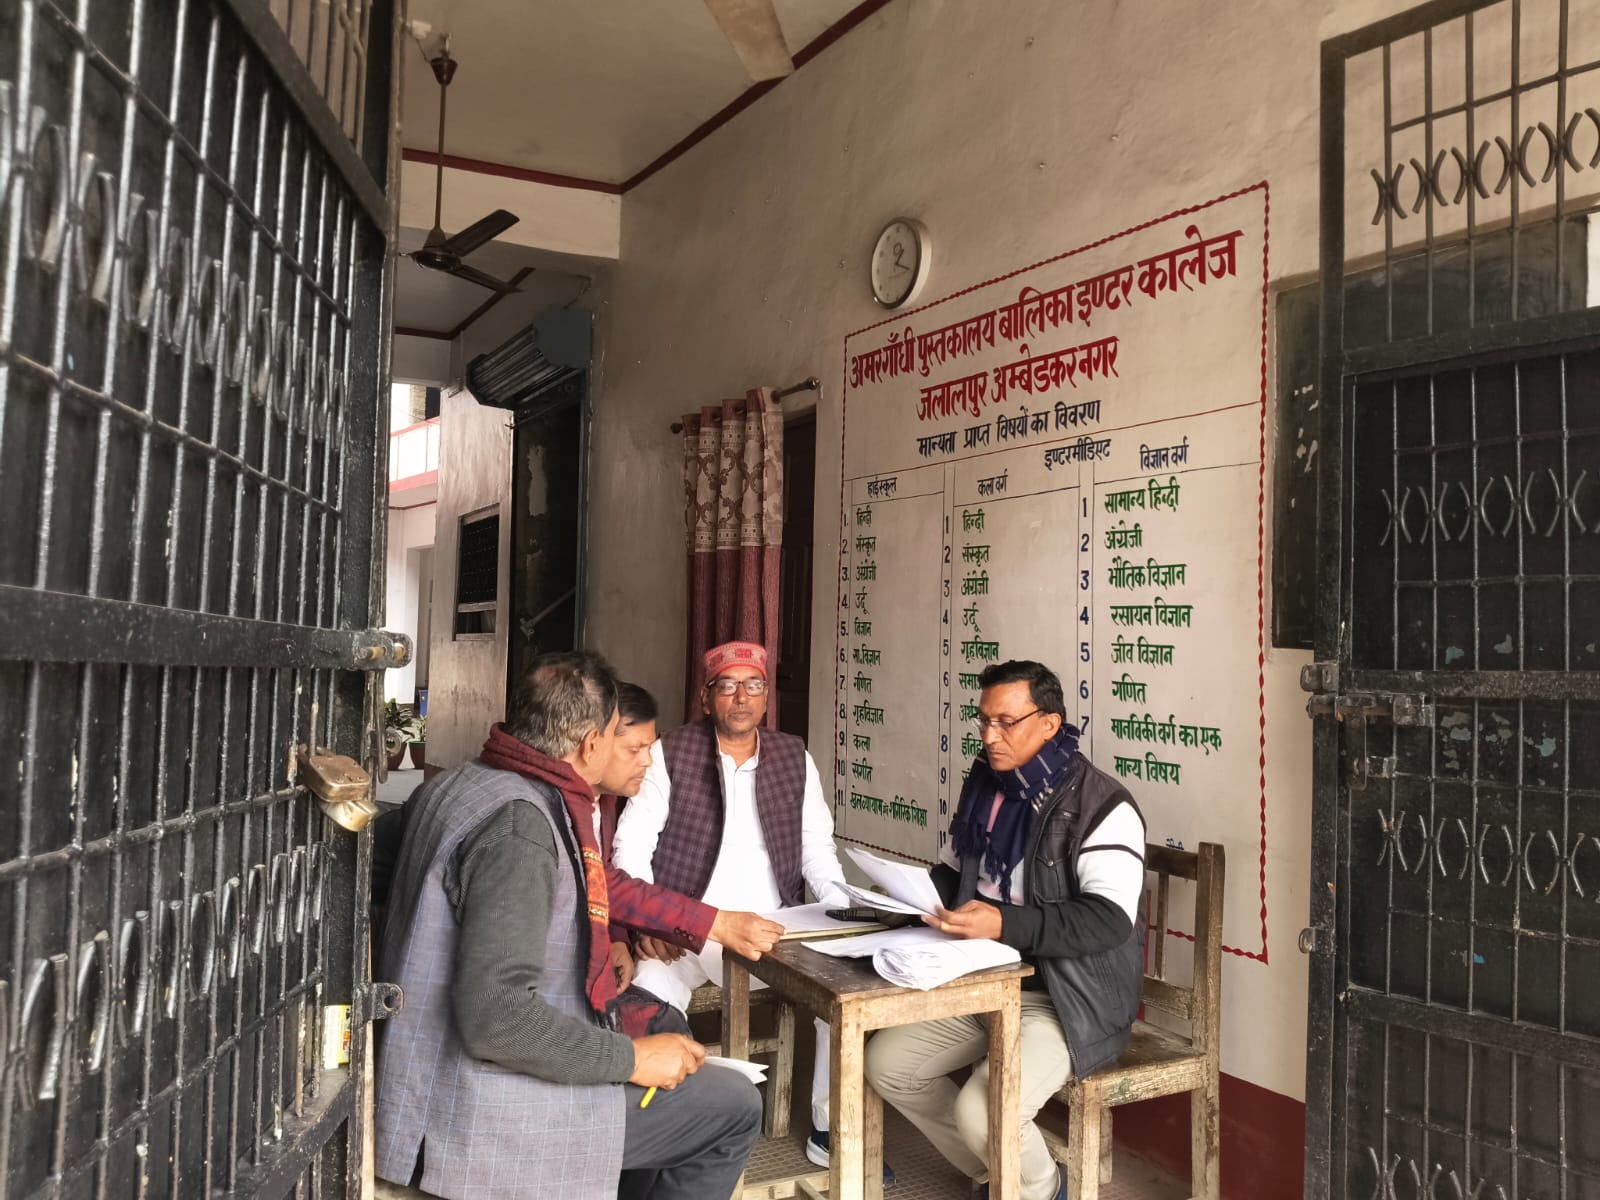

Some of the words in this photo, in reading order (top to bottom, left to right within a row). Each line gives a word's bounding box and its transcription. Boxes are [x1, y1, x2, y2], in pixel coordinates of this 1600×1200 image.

[917, 310, 997, 378] पुस्तकालय
[998, 285, 1075, 341] बालिका
[1076, 264, 1135, 328] इण्टर
[1137, 224, 1244, 300] कालेज
[915, 371, 989, 422] जलालपुर
[916, 431, 958, 459] मान्यता
[963, 423, 991, 449] प्राप्त
[996, 406, 1030, 443] विषयों
[1030, 410, 1051, 435] का
[1054, 399, 1101, 431] विवरण
[1043, 436, 1112, 471] इण्टरमीडिएट
[1139, 443, 1170, 471] विज्ञान
[1170, 435, 1190, 466] वर्ग
[977, 477, 994, 497] कला
[995, 468, 1009, 492] वर्ग
[1082, 497, 1087, 518] 1
[1105, 489, 1146, 514] सामान्य
[1148, 475, 1180, 513] हिन्दी
[945, 515, 950, 534] 1
[963, 508, 985, 533] हिन्दी
[1080, 533, 1090, 552] 2
[1105, 520, 1142, 550] अंग्रेजी
[944, 545, 951, 564] 2
[962, 543, 991, 567] संस्कृत
[943, 579, 950, 598] 3
[961, 570, 989, 597] अंग्रेजी
[1080, 570, 1089, 591] 3
[1108, 556, 1146, 591] भौतिक
[1147, 557, 1187, 590] विज्ञान
[855, 586, 870, 615] उर्दू
[1079, 606, 1089, 625] 4
[1110, 604, 1153, 627] रसायन
[1154, 596, 1193, 629] विज्ञान
[942, 609, 949, 625] 4
[962, 601, 981, 633] उर्दू
[942, 639, 949, 657] 5
[1080, 642, 1090, 662] 5
[1111, 634, 1134, 664] जीव
[1137, 635, 1175, 668] विज्ञान
[853, 670, 872, 694] गणित
[943, 671, 949, 688] 6
[1079, 680, 1089, 700] 6
[1112, 672, 1147, 704] गणित
[943, 702, 949, 720] 7
[853, 733, 871, 752] कला
[941, 734, 948, 753] 8
[1080, 715, 1090, 736] 7
[1111, 713, 1157, 743] मानविकी
[1158, 714, 1176, 745] वर्ग
[1178, 724, 1198, 748] का
[1199, 726, 1222, 756] एक
[851, 757, 873, 784] संगीत
[940, 767, 947, 785] 9
[1113, 755, 1143, 780] मान्य
[1145, 751, 1181, 786] विषय
[939, 798, 947, 815] 10
[939, 830, 947, 849] 11
